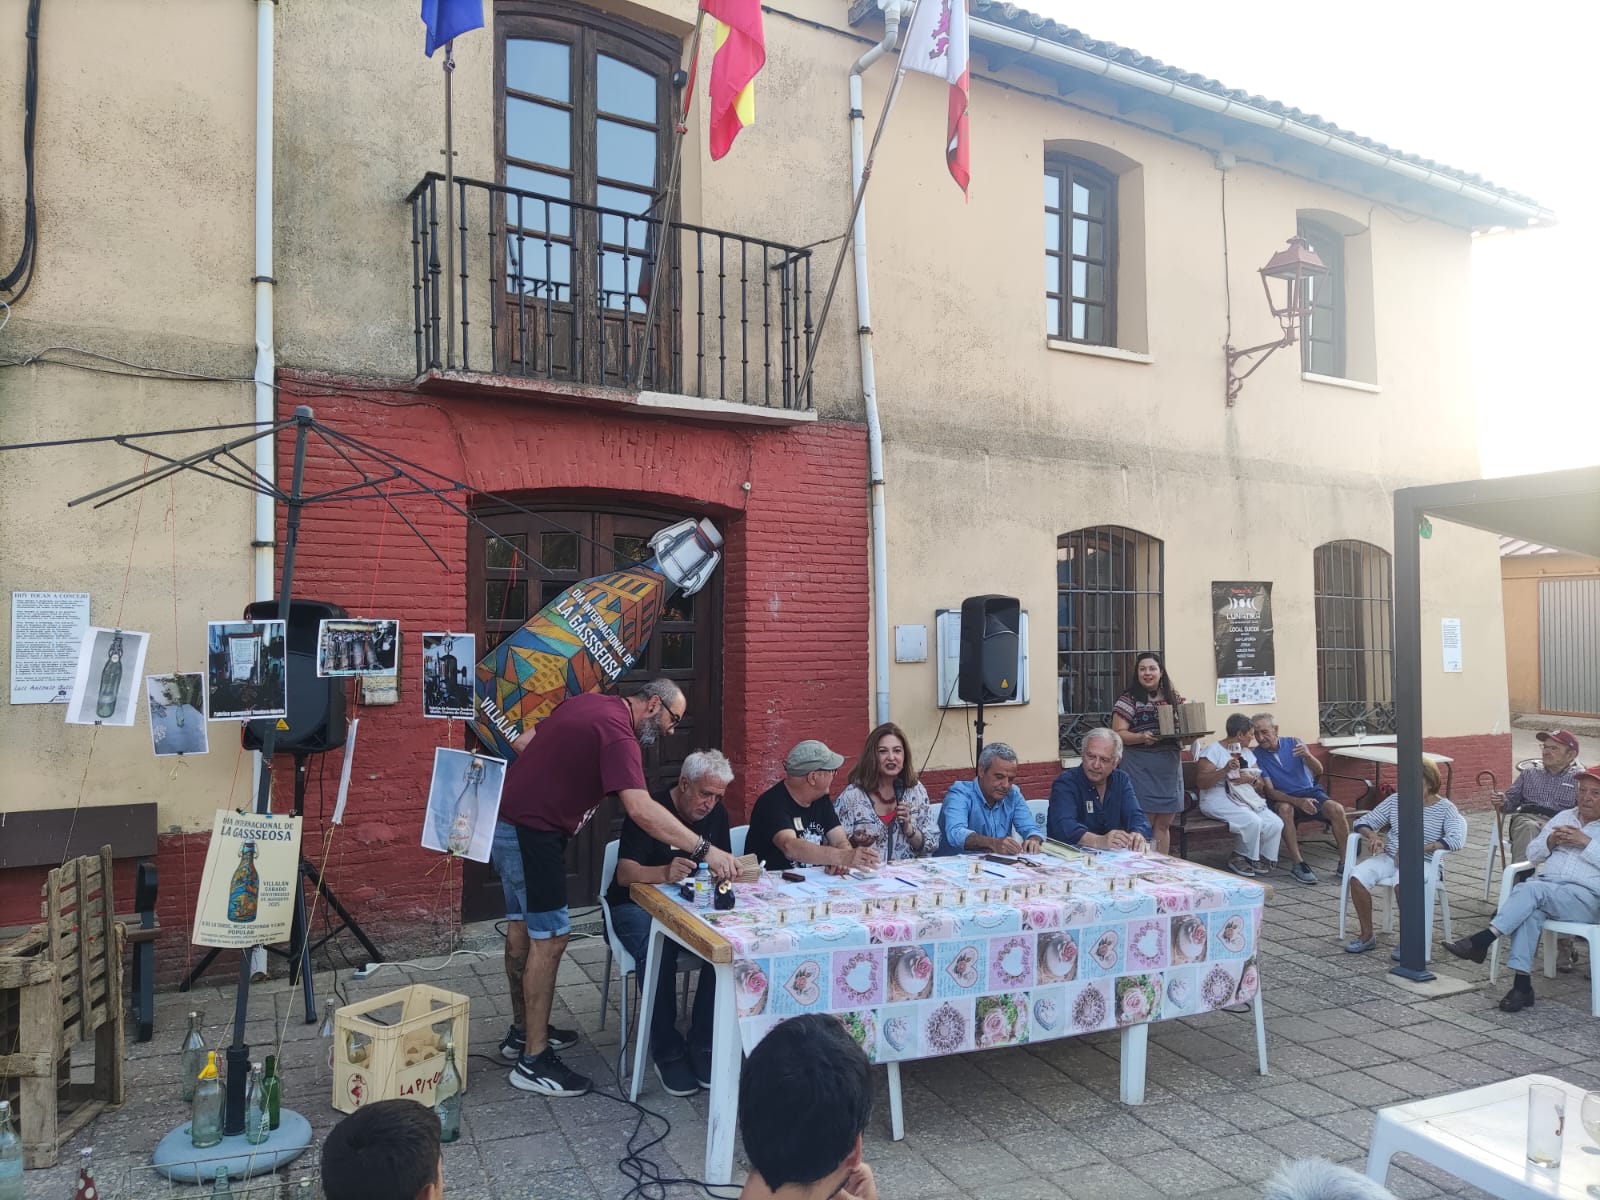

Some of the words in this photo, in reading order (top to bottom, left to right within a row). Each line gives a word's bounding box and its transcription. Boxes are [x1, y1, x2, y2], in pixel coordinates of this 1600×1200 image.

[556, 599, 574, 618] LA
[568, 614, 622, 680] GASSSEOSA
[572, 588, 585, 604] DÍA
[582, 601, 624, 656] INTERNACIONAL
[622, 653, 635, 667] DE
[480, 696, 520, 743] VILLALÁN
[221, 826, 231, 836] LA
[232, 827, 292, 841] GASSSEOSA
[234, 819, 281, 829] INTERNACIONAL
[400, 1083, 414, 1097] LA
[415, 1071, 442, 1095] PITU
